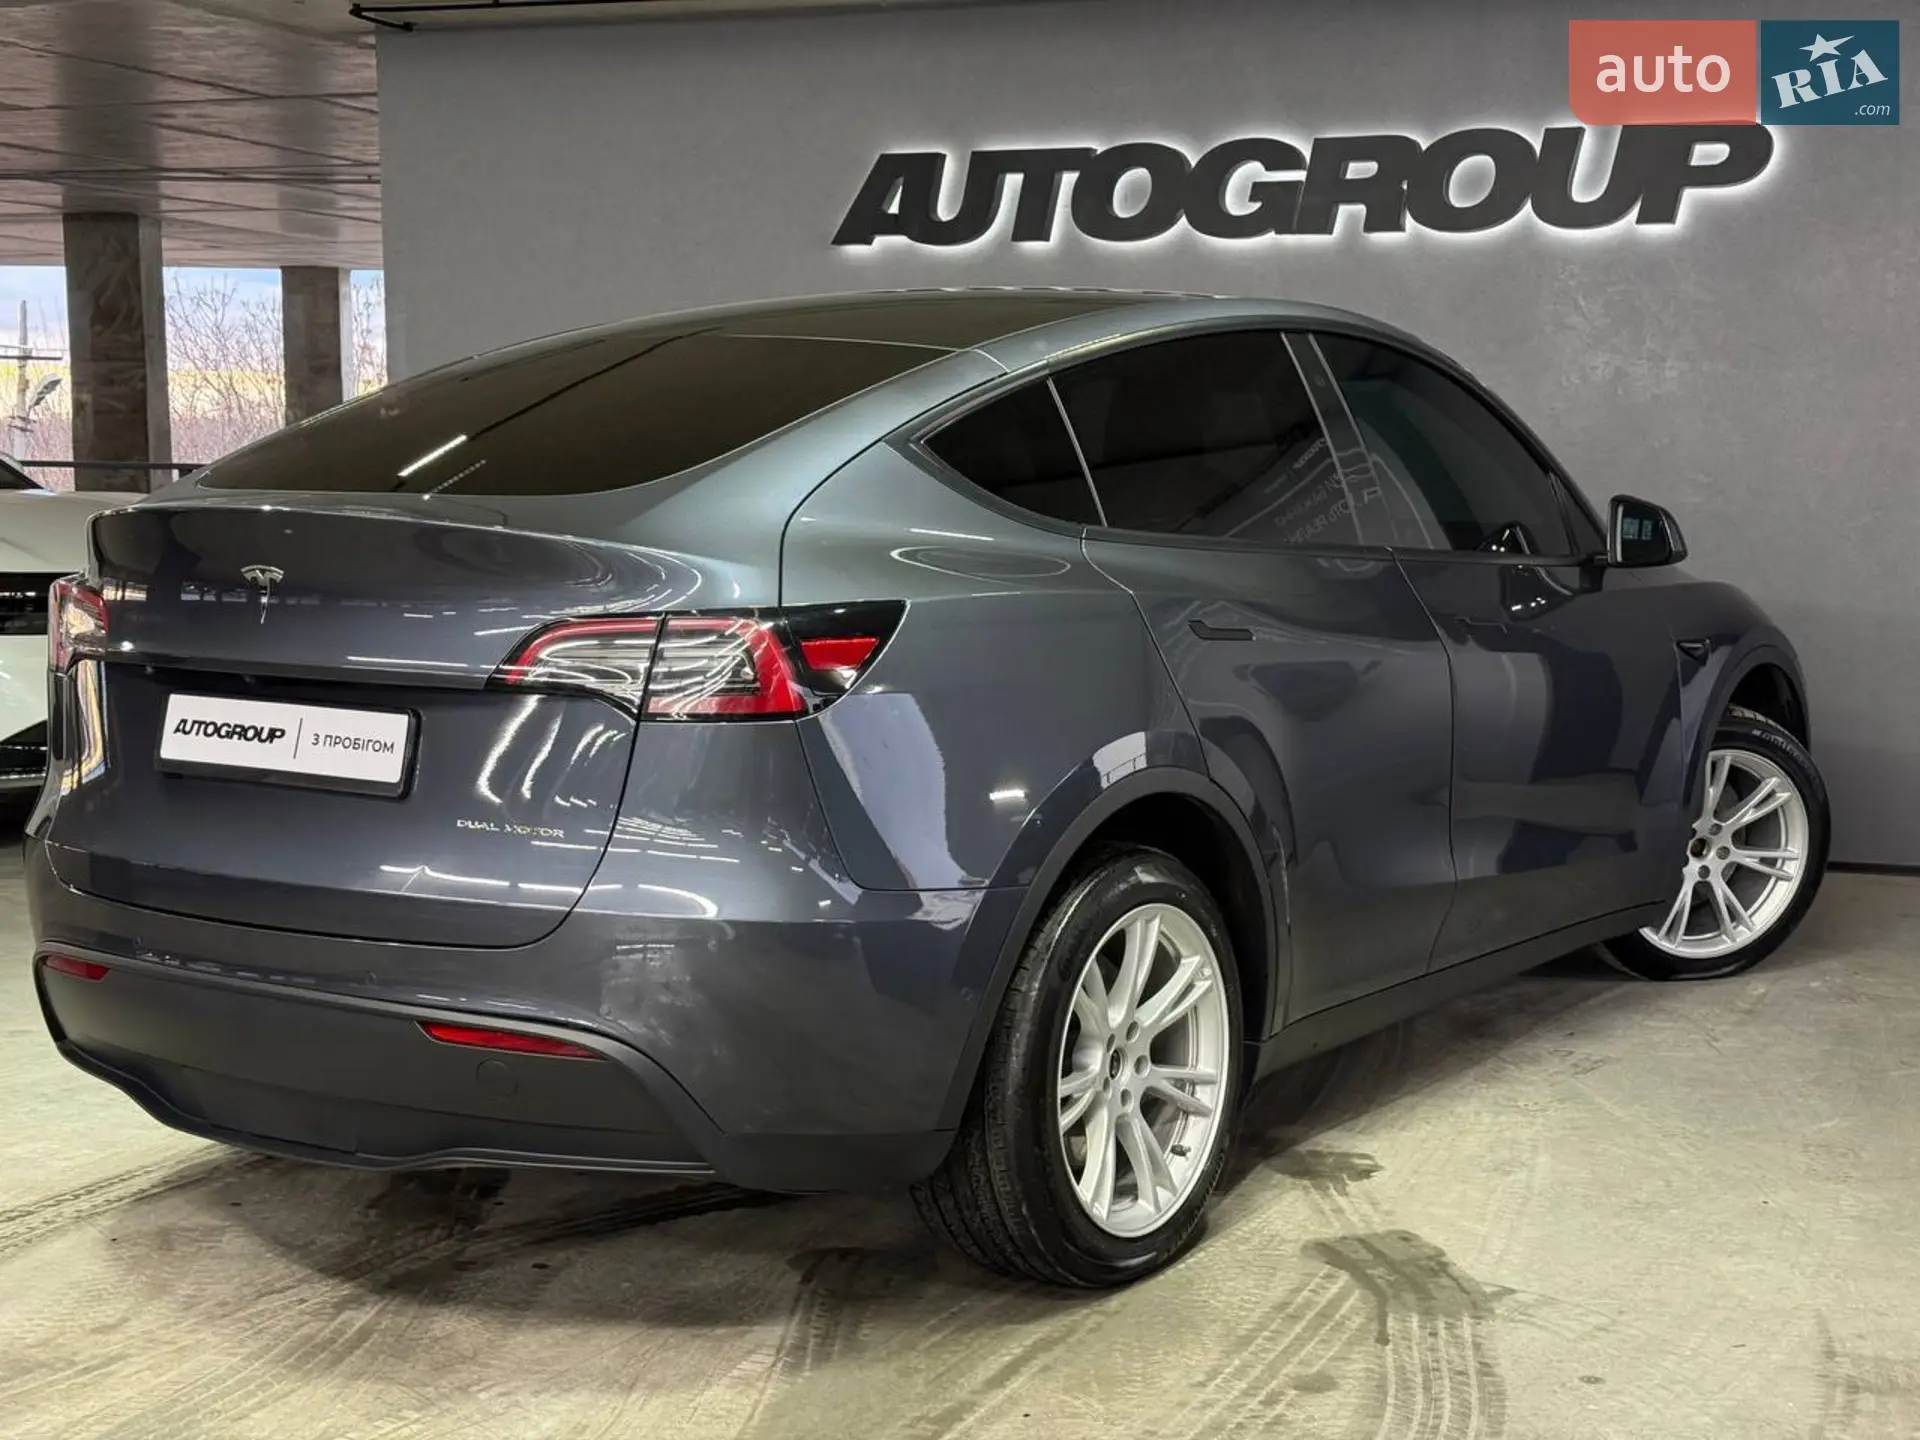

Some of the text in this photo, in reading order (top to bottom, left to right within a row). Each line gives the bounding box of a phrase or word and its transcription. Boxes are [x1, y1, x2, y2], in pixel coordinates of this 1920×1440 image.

[830, 121, 1774, 247] AUTOGROUP
[173, 718, 286, 744] AUTOGROUP
[323, 734, 395, 754] ПРОБІГОМ
[456, 819, 500, 832] DUAL
